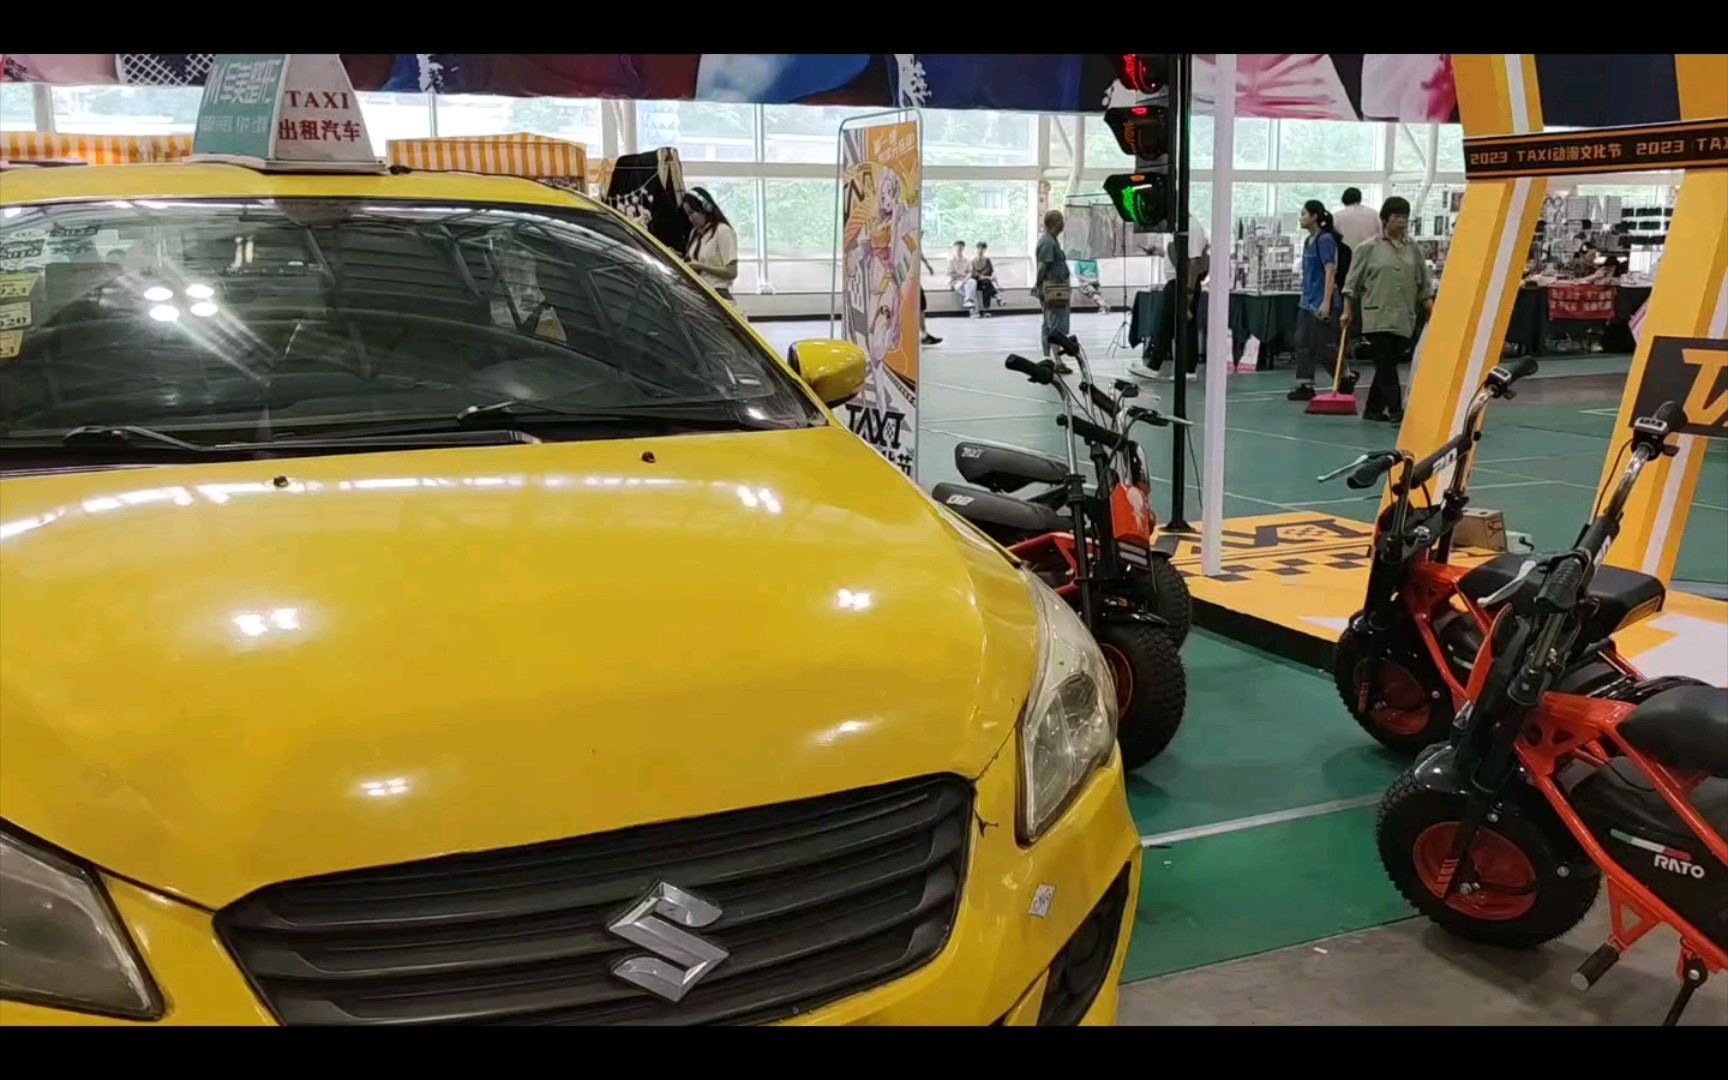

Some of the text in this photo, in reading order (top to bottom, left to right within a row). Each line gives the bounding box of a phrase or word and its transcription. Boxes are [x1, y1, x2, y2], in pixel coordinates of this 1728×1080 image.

[285, 90, 350, 110] TAXI
[279, 118, 361, 142] 出租汽车
[1470, 150, 1508, 165] 2023
[1636, 140, 1686, 156] 2023
[1653, 853, 1706, 879] RATO
